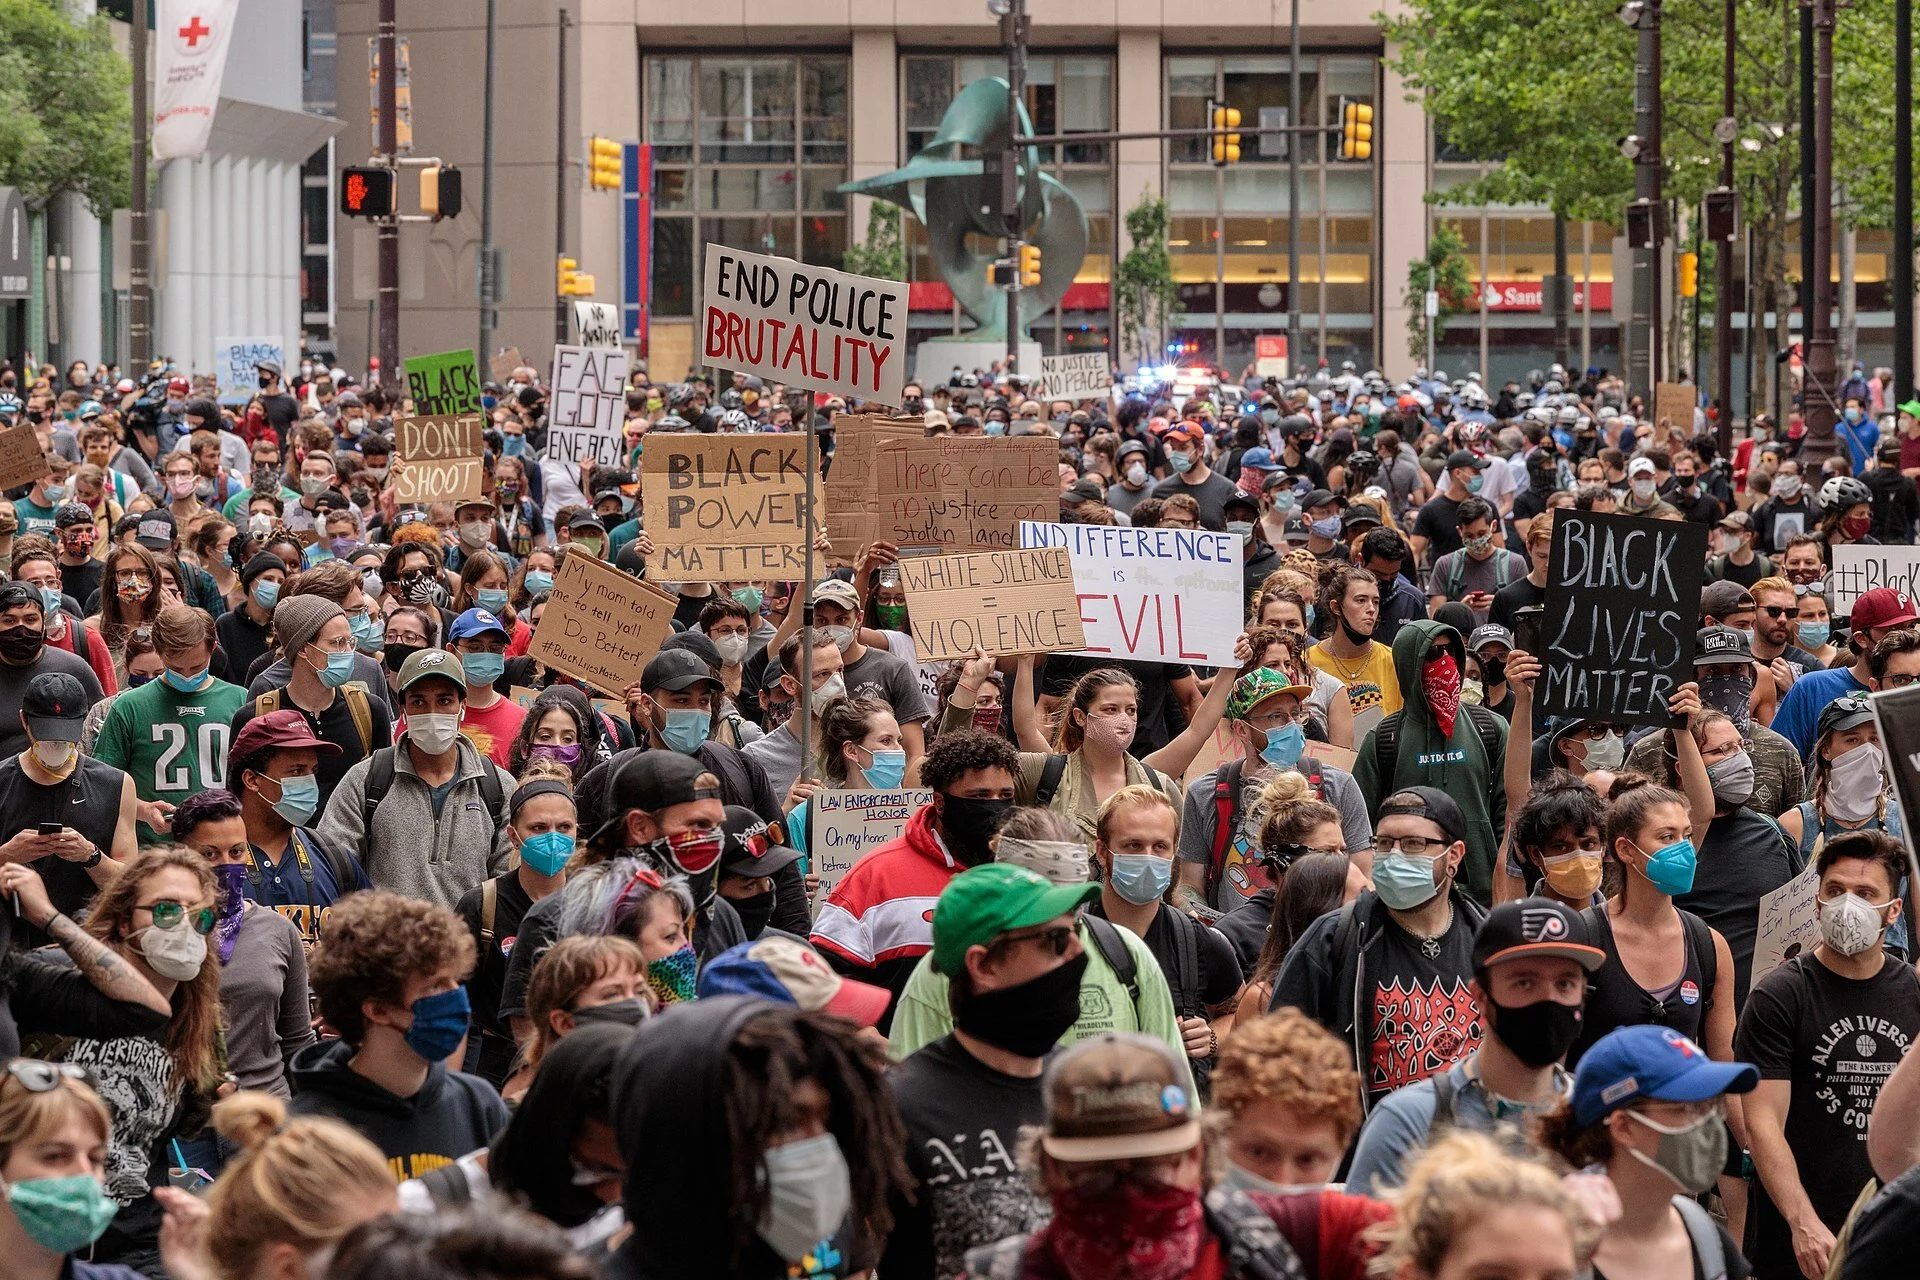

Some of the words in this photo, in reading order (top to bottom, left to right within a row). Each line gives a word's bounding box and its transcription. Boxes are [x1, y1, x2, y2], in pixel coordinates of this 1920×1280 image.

[590, 303, 604, 320] NO
[718, 256, 780, 308] END
[789, 273, 897, 340] POLICE
[582, 320, 620, 347] JUSTICE
[706, 305, 891, 392] BRUTALITY
[230, 343, 281, 363] BLACK
[1041, 358, 1056, 373] NO
[1060, 355, 1102, 373] JUSTICE
[232, 372, 257, 383] MAT
[408, 364, 479, 401] BLACK
[557, 351, 626, 396] FAG
[1042, 375, 1061, 397] NO
[1065, 370, 1105, 393] PEACE
[554, 390, 622, 430] GOT
[549, 431, 621, 465] ENERGY
[397, 462, 479, 499] SHOOT
[668, 447, 807, 489] BLACK
[883, 448, 958, 489] There
[968, 466, 1012, 488] can
[1027, 455, 1055, 486] be
[667, 493, 819, 532] POWER
[892, 497, 920, 520] no
[924, 489, 999, 528] justice
[1014, 504, 1047, 520] on
[140, 521, 169, 536] ACAB
[893, 523, 956, 542] stolen
[969, 520, 1014, 546] land
[1022, 522, 1232, 563] INDIFFERENCE
[662, 544, 806, 571] MATTERS
[903, 555, 983, 590] WHITE
[992, 549, 1068, 584] SILENCE
[1560, 518, 1678, 602] BLACK
[565, 559, 593, 599] My
[596, 584, 627, 605] mom
[630, 600, 656, 620] told
[1113, 567, 1125, 583] is
[552, 589, 569, 603] me
[574, 599, 587, 611] to
[591, 606, 612, 623] tell
[912, 609, 1074, 656] VIOLENCE
[1076, 594, 1208, 660] EVIL
[1548, 595, 1681, 670] LIVES
[1543, 661, 1674, 719] MATTER
[152, 722, 231, 791] 20
[1419, 754, 1435, 764] JUT
[820, 794, 841, 810] LAW
[845, 792, 912, 809] ENFORCEMENT
[914, 793, 934, 804] OAT
[866, 808, 911, 820] HONOR
[825, 827, 843, 847] On
[845, 831, 861, 850] my
[1766, 892, 1787, 918] Let
[1762, 917, 1783, 939] I'm
[1831, 926, 1862, 944] LIVES
[1073, 1021, 1114, 1030] PHILADELPHIA
[1811, 1017, 1855, 1067] ALLEN
[1856, 1015, 1911, 1056] IVERS
[1826, 1075, 1887, 1083] PHILADELPHI
[1847, 1085, 1871, 1095] JULY
